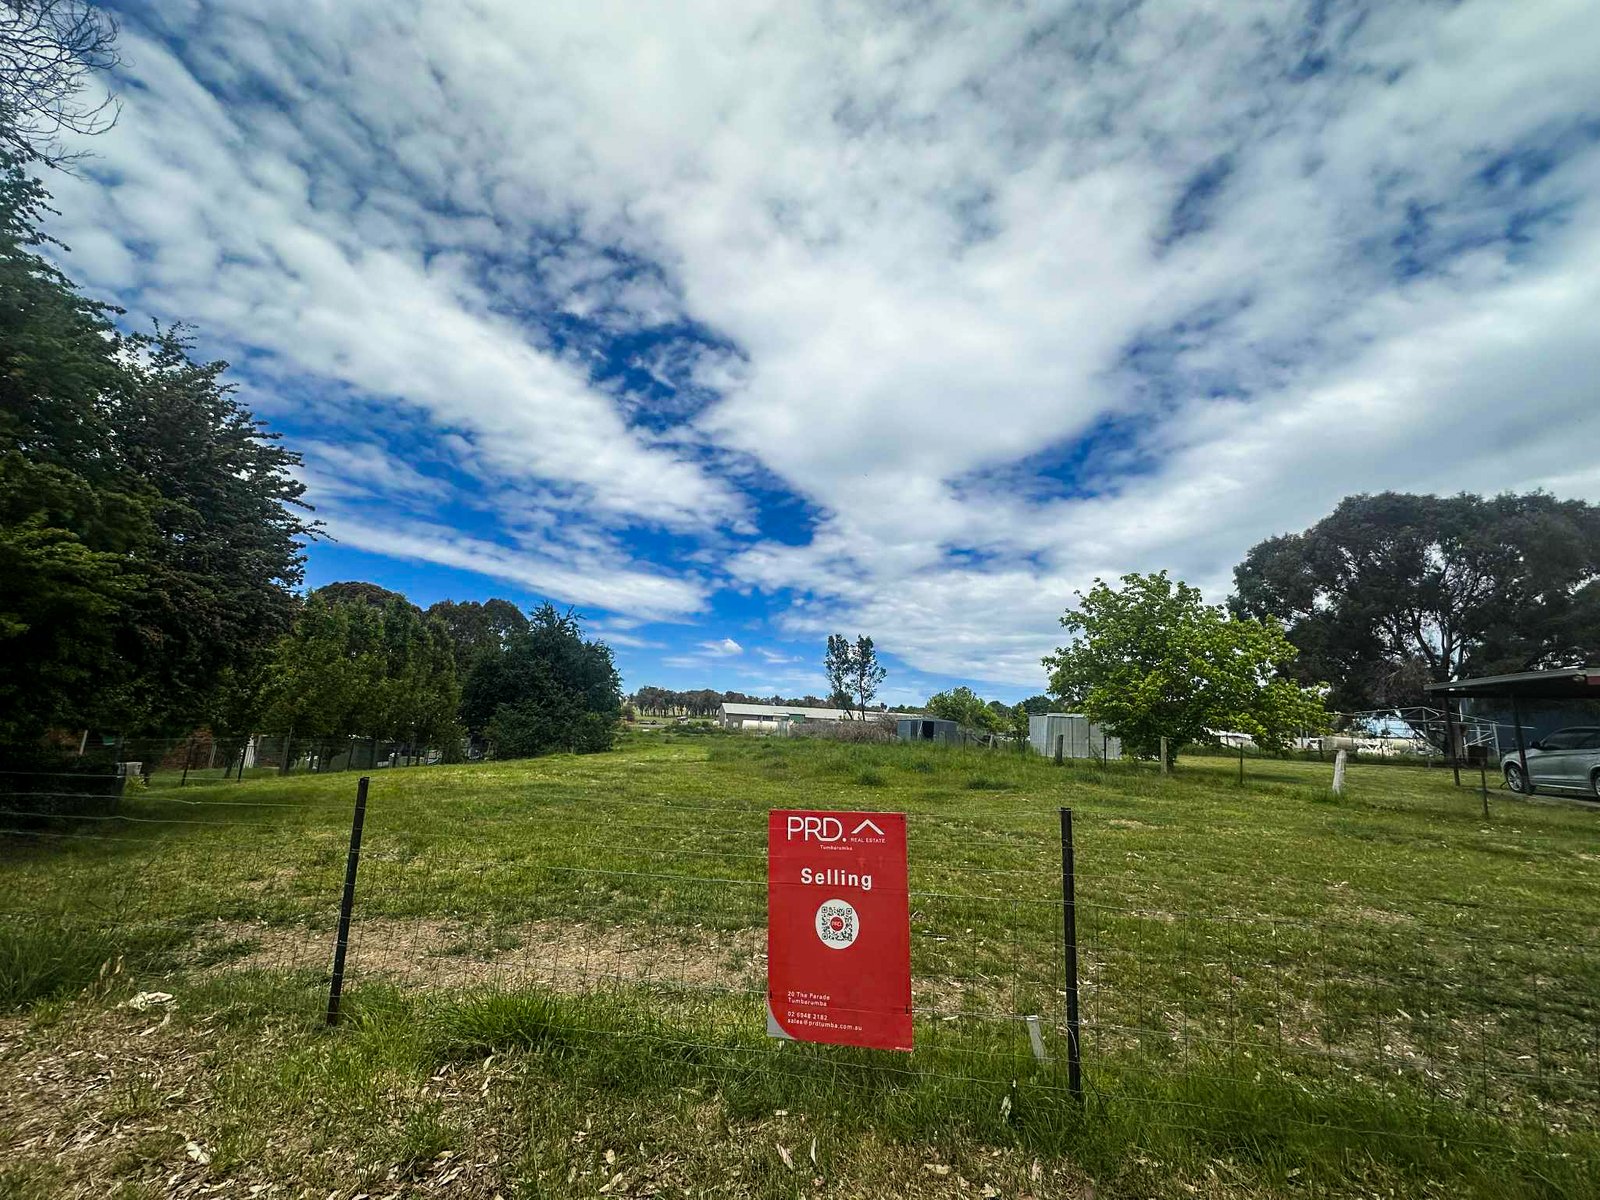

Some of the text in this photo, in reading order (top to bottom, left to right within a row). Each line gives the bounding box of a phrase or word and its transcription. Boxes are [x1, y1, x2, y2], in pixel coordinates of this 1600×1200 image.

[800, 867, 872, 891] Selling
[788, 997, 827, 1007] Tumbarumba
[809, 993, 830, 1001] Parade
[812, 1013, 828, 1021] 2182
[787, 1018, 863, 1031] sales@prdtumba.com.au
